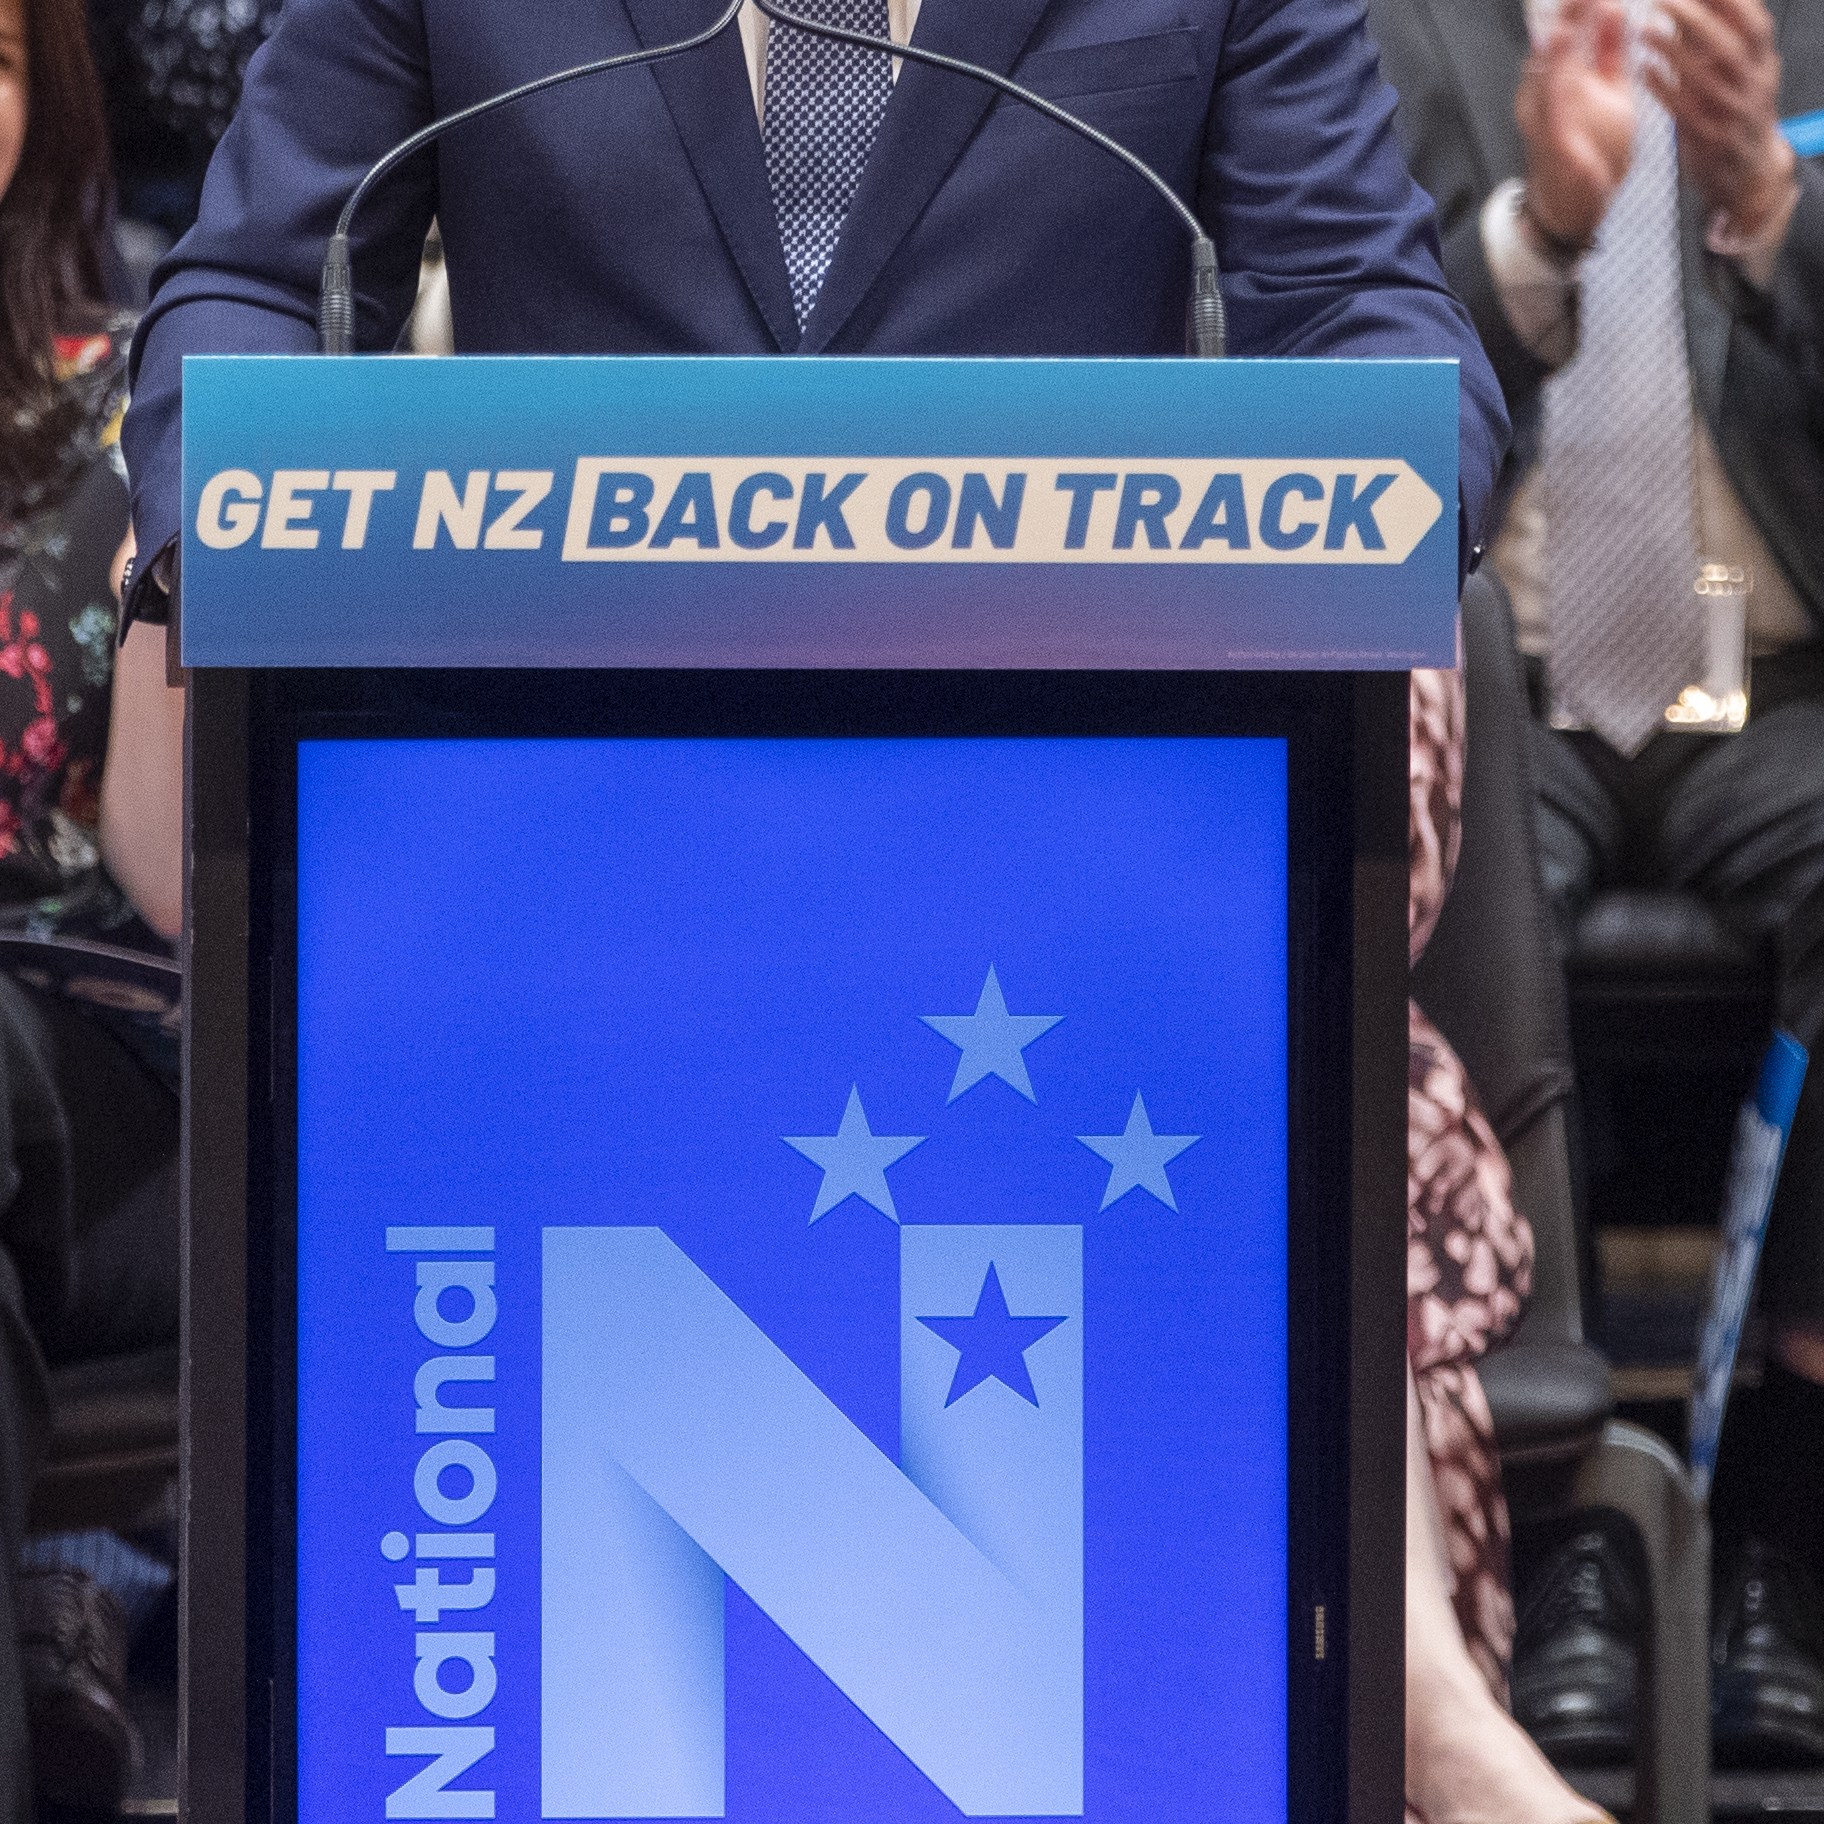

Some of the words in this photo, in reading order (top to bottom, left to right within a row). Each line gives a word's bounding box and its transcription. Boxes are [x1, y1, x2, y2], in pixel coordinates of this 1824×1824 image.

[197, 469, 397, 549] GET
[413, 470, 556, 549] NZ
[586, 471, 868, 549] BACK
[885, 471, 1028, 550] ON
[1054, 472, 1400, 551] TRACK
[380, 1225, 499, 1820] National
